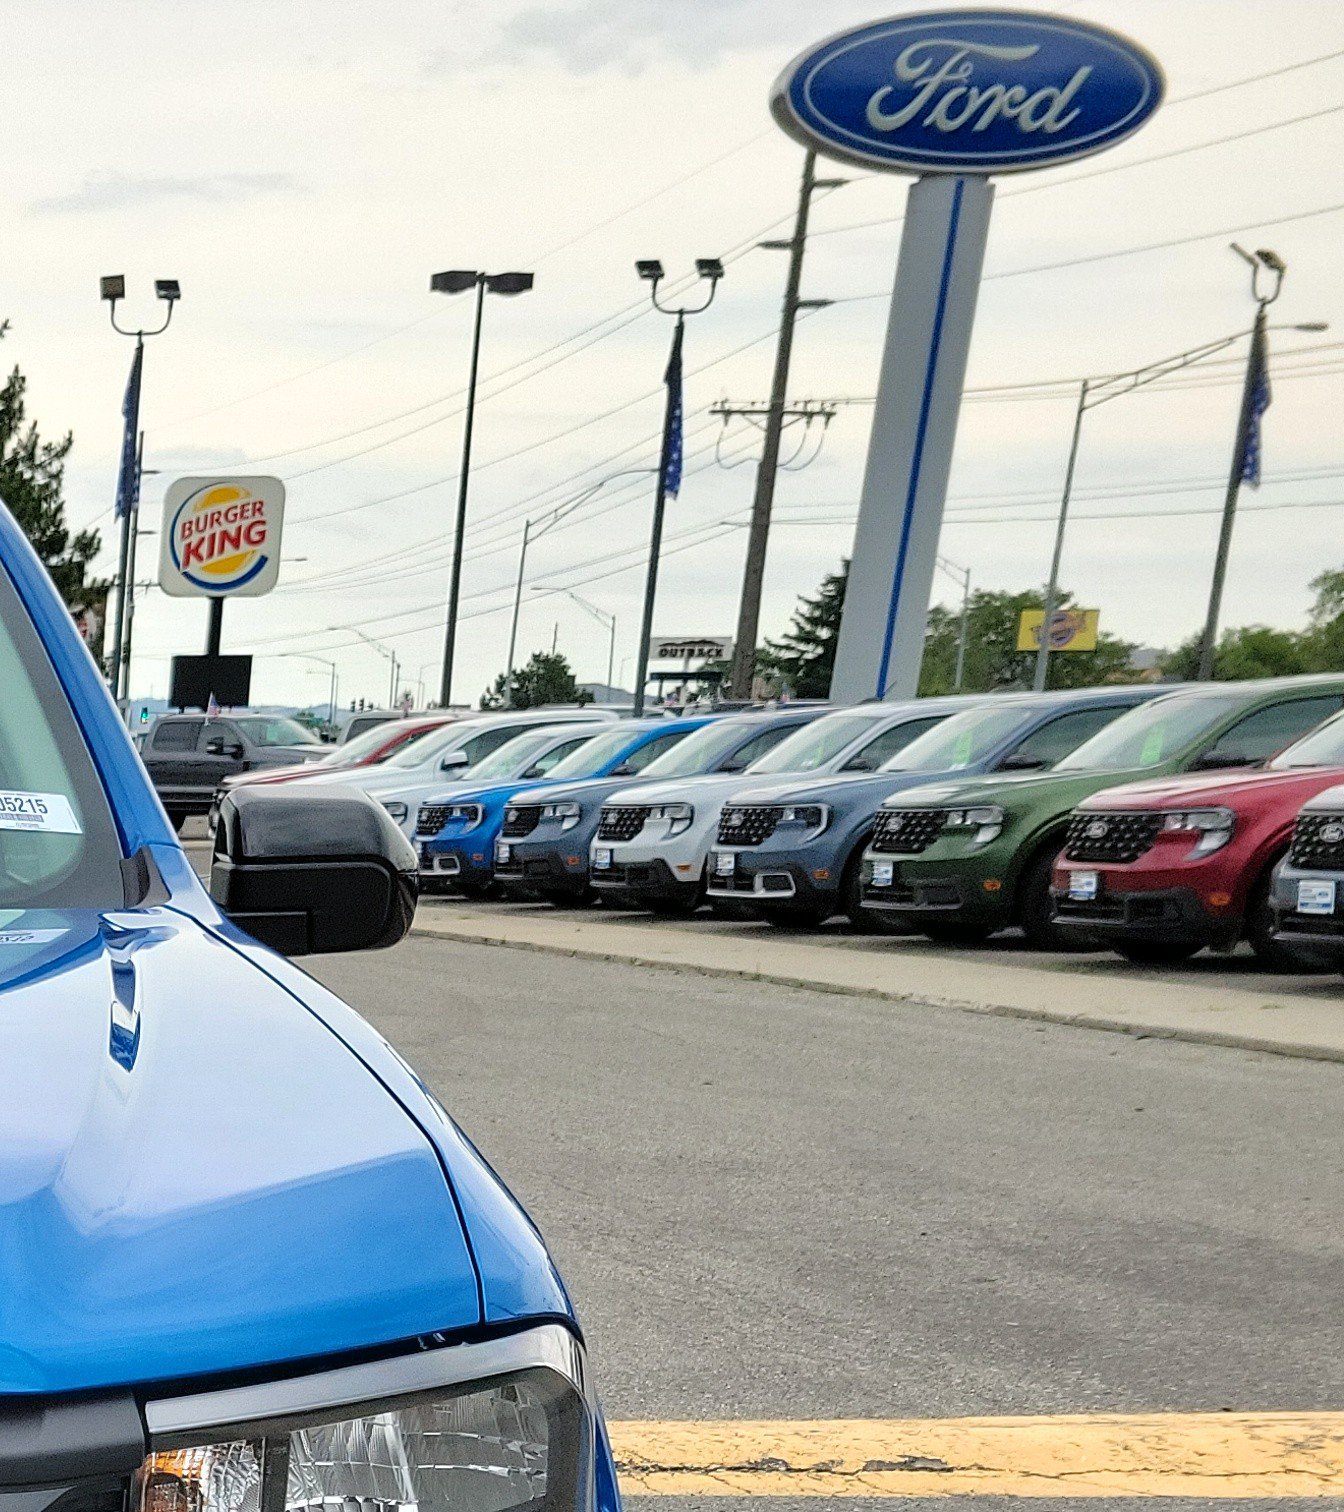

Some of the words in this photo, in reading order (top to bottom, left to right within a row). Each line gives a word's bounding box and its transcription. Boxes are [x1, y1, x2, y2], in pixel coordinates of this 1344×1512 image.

[866, 38, 1093, 133] Ford
[180, 500, 265, 541] BURGER
[181, 519, 267, 570] KING
